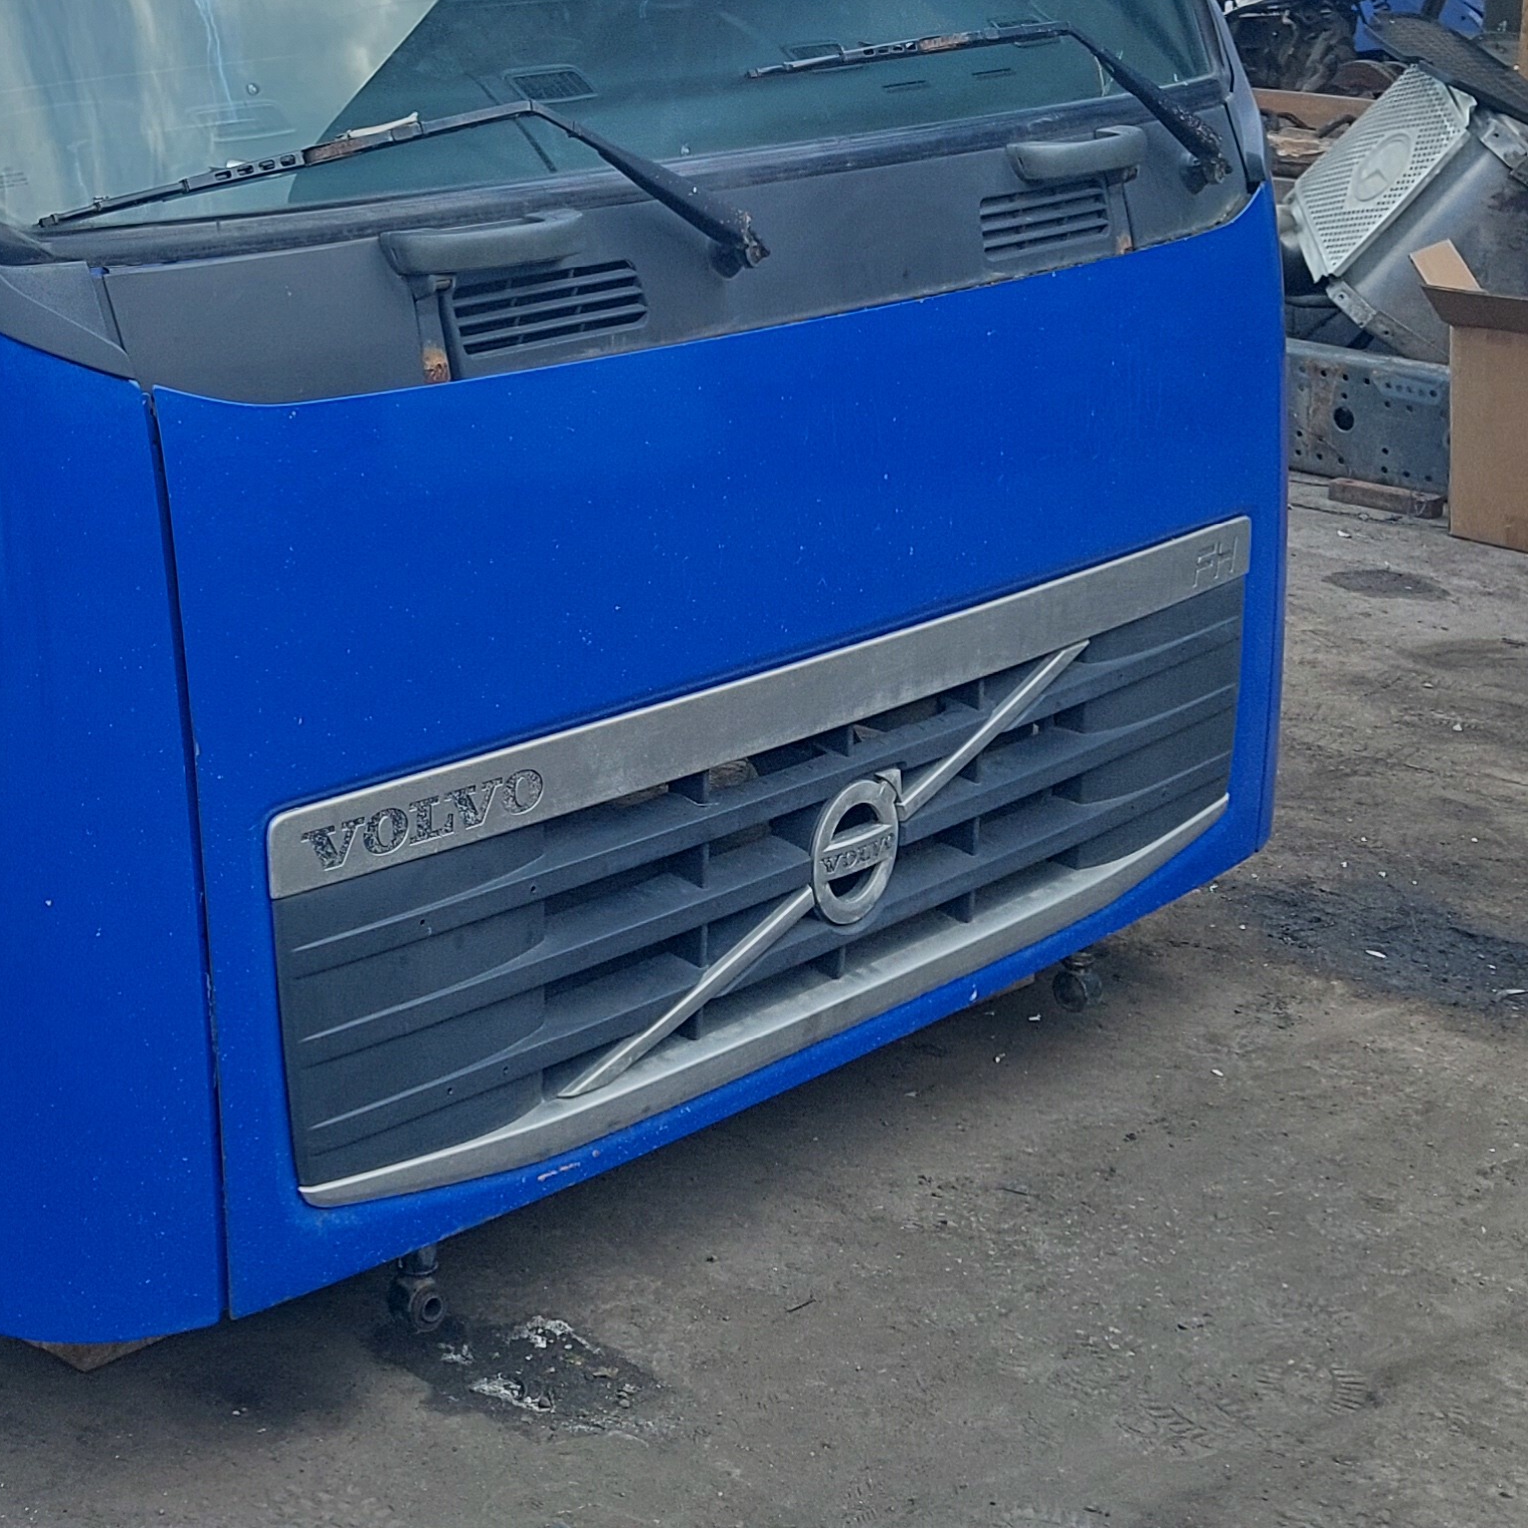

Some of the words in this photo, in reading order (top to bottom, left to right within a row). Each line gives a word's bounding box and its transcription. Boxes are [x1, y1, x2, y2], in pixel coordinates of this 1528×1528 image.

[1192, 536, 1239, 589] FH
[300, 767, 545, 872] VOLVO
[819, 831, 896, 875] VOLVO
